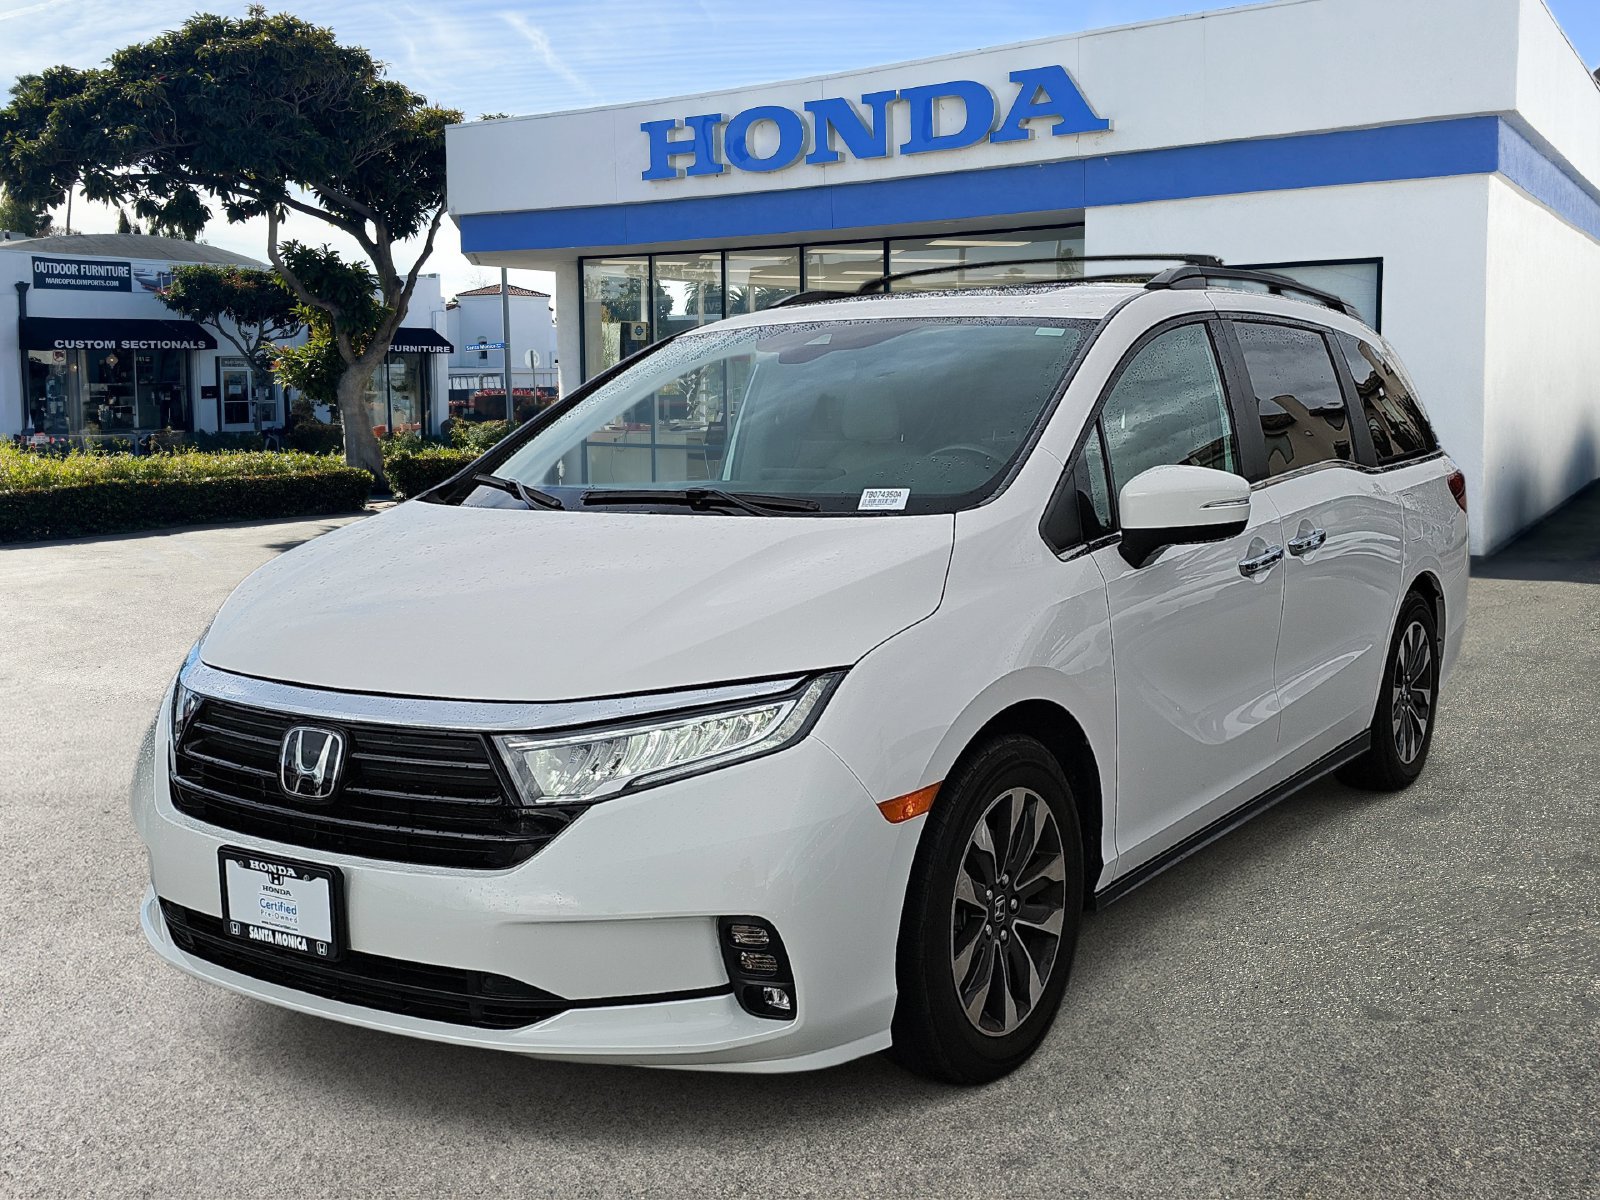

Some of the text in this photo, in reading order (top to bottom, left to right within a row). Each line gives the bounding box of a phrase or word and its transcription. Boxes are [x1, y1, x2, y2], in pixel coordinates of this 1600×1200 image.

[641, 64, 1114, 181] HONDA
[34, 261, 130, 277] OUTDOOR FURNITURE
[45, 277, 119, 287] MARCOPOLOIMPORTS.COM
[54, 339, 206, 349] CUSTOM SECTIONALS
[388, 344, 451, 353] FURNITURE
[249, 860, 297, 877] HONDA
[262, 885, 292, 896] HONDA
[260, 898, 297, 915] Certified
[260, 909, 298, 923] Pre-Owned
[249, 926, 308, 951] SANTA MONICA
